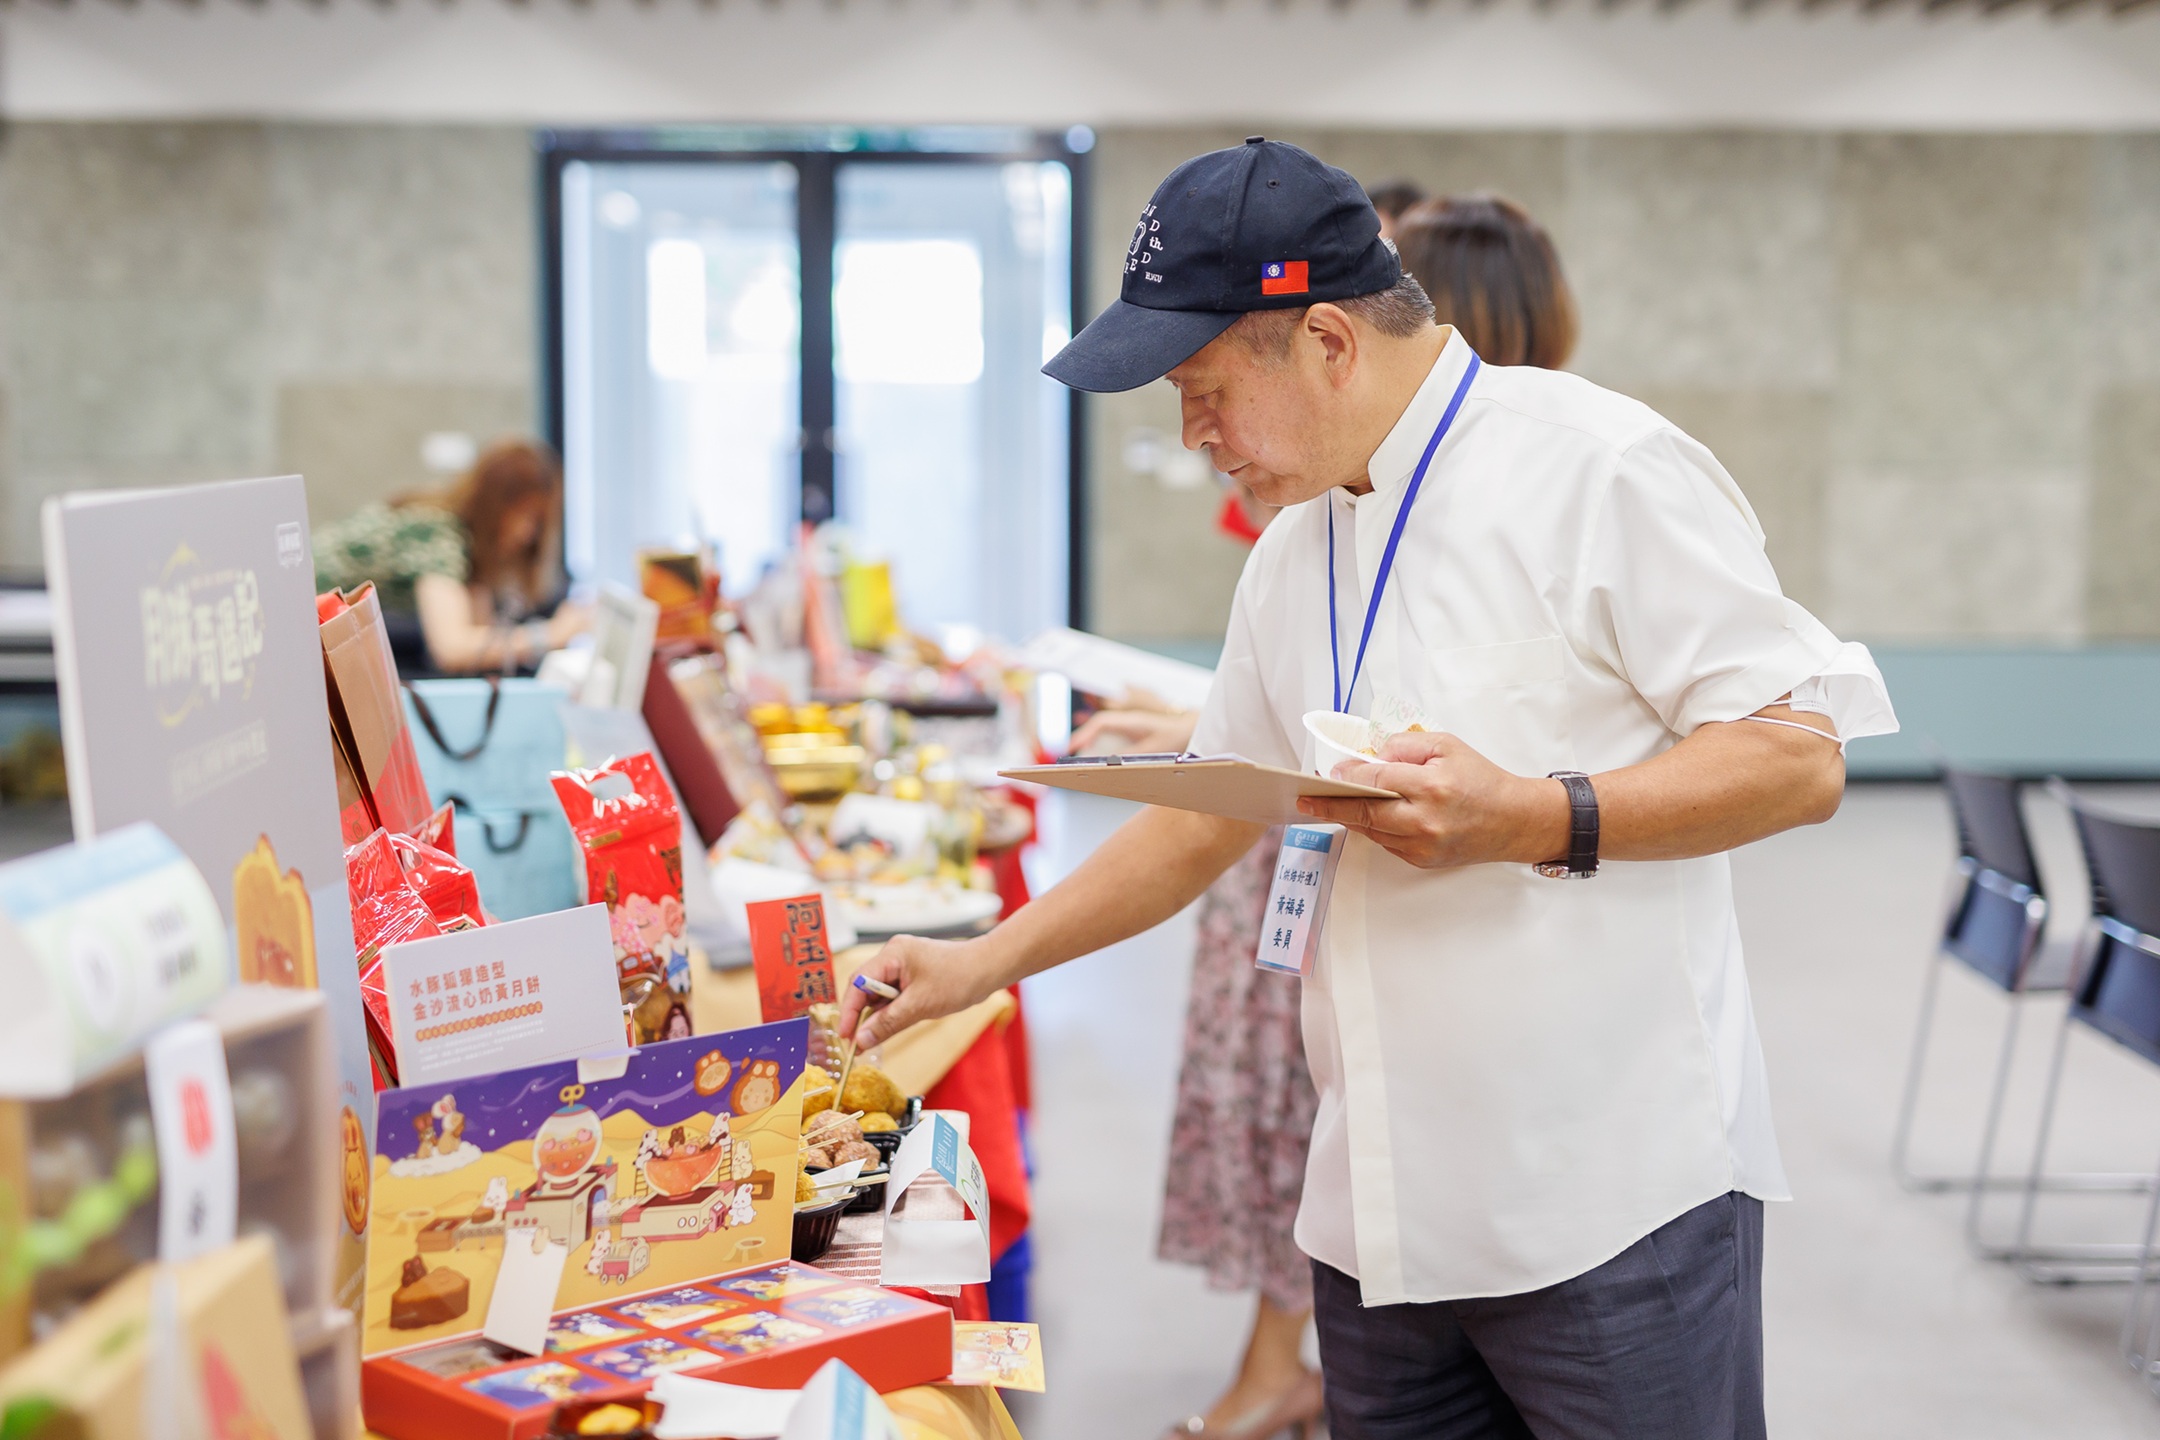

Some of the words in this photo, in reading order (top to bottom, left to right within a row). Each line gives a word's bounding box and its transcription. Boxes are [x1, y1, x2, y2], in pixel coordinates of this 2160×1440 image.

[1273, 927, 1293, 950] 委員
[412, 975, 541, 1021] 金沙流心奶黃月餅
